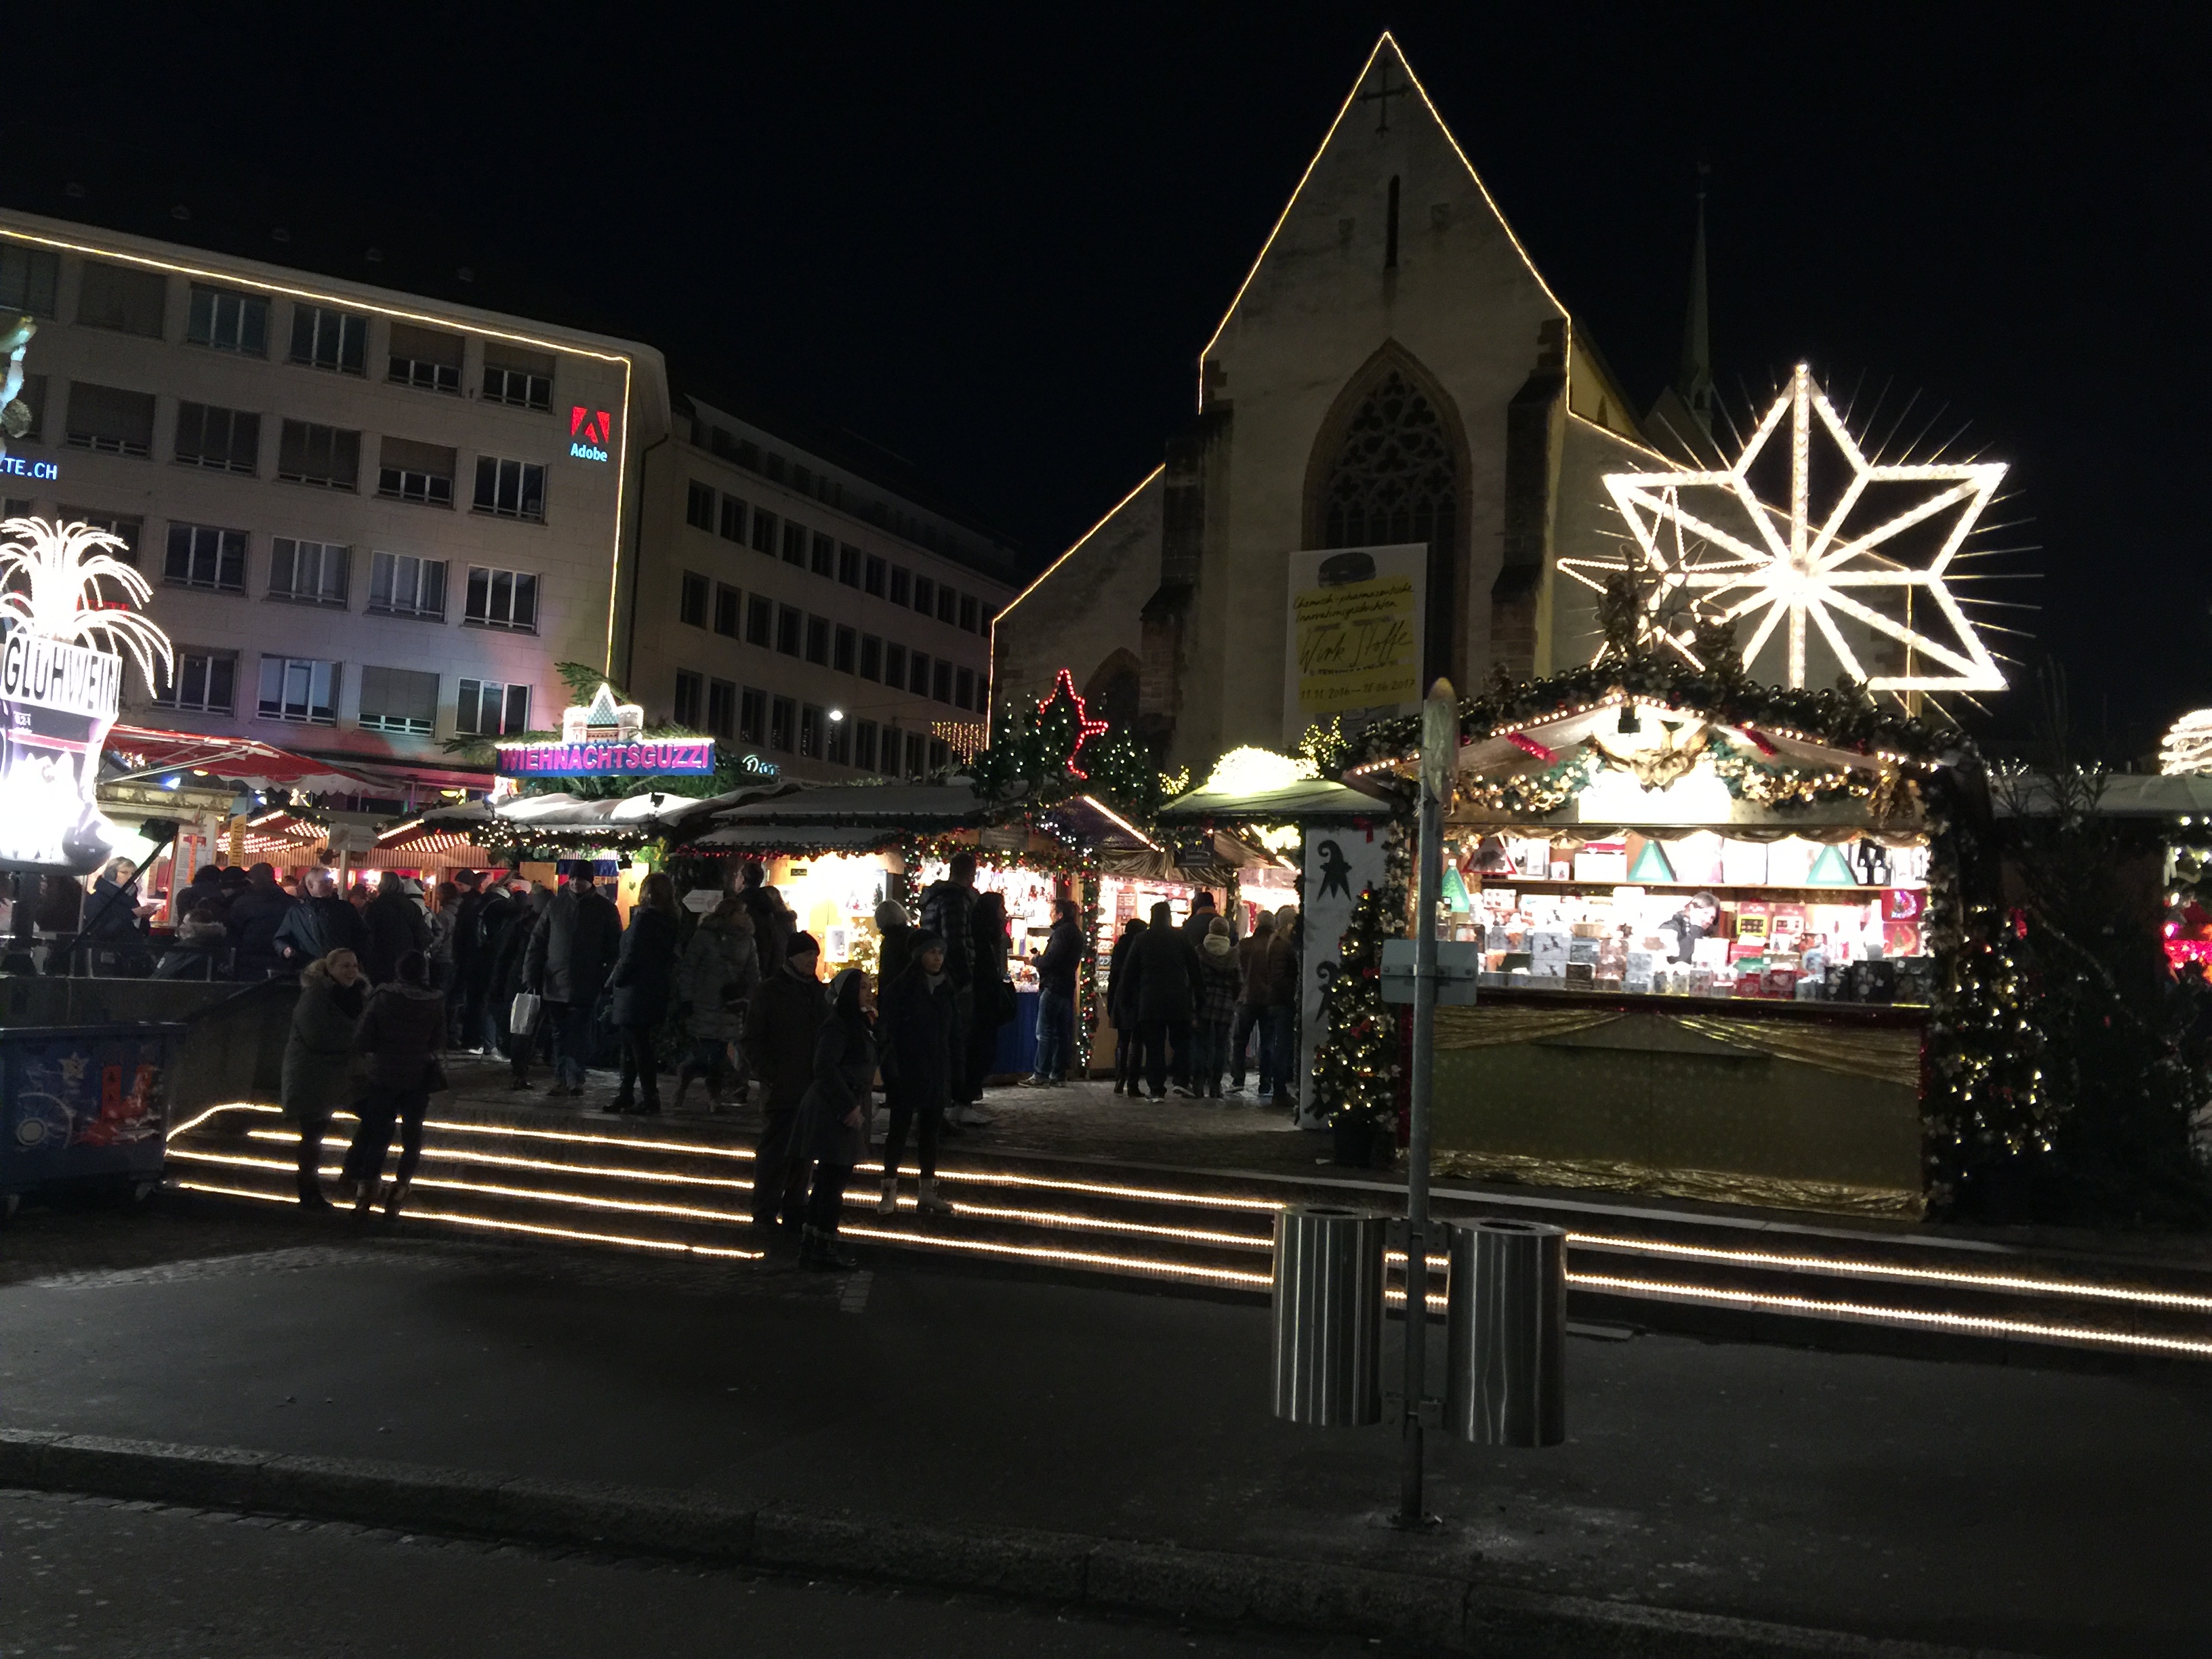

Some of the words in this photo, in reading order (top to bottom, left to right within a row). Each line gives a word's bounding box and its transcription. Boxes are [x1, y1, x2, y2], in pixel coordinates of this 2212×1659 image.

[571, 443, 607, 462] Adobe
[0, 457, 58, 480] TE.CH
[4, 636, 120, 714] GLÜHWEIN
[501, 744, 709, 771] WIEHNACHTSGUZZI
